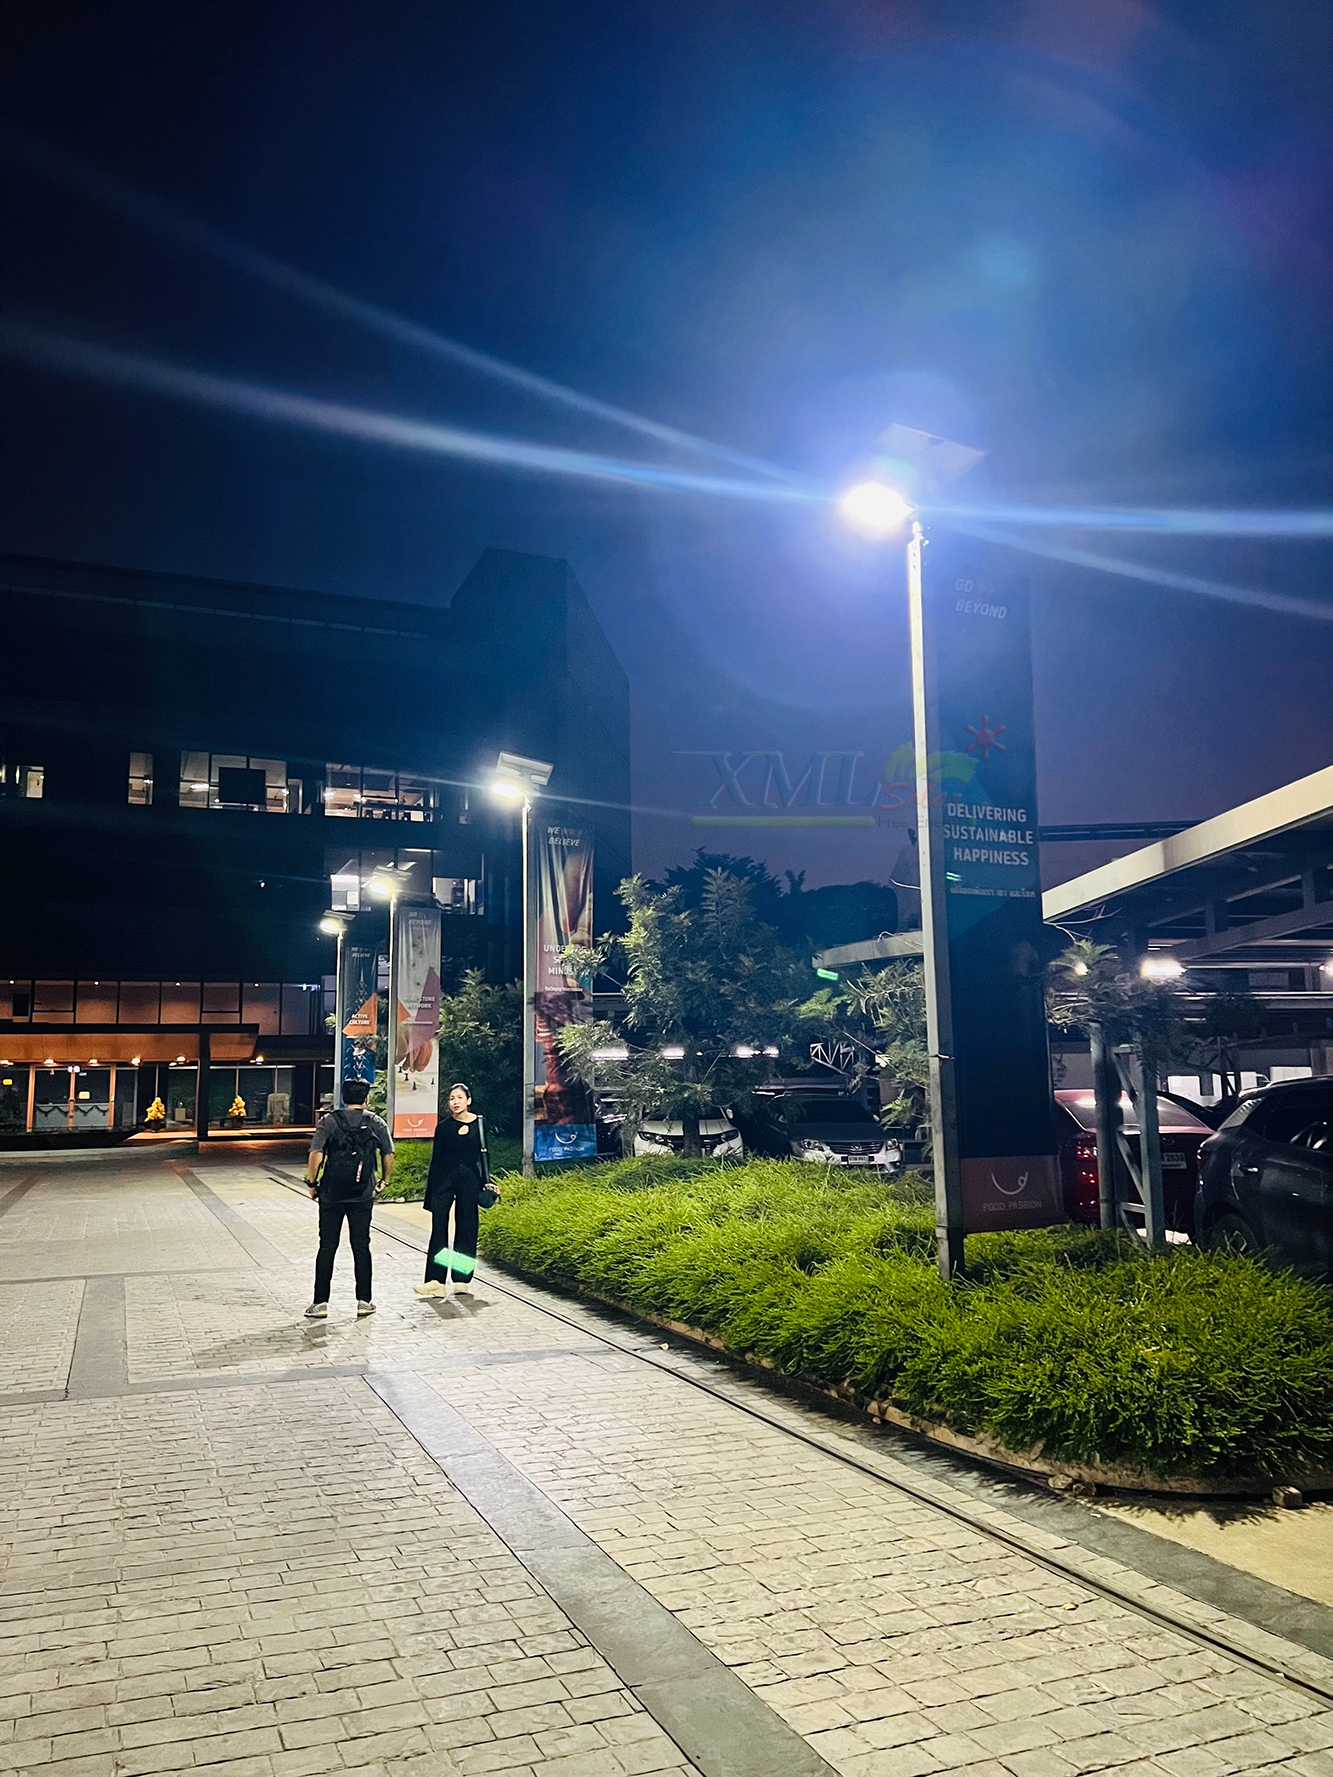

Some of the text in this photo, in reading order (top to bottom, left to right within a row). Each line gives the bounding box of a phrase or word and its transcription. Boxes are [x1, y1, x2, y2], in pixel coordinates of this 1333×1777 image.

[955, 579, 974, 592] GO
[955, 598, 1007, 619] BEYOND
[947, 803, 1027, 823] DELIVERING
[547, 826, 560, 834] WE
[943, 824, 1034, 845] SUSTAINABLE
[548, 836, 581, 847] BELIEVE
[953, 847, 1029, 866] HAPPINESS
[982, 1200, 1042, 1212] FOOD PASSION
